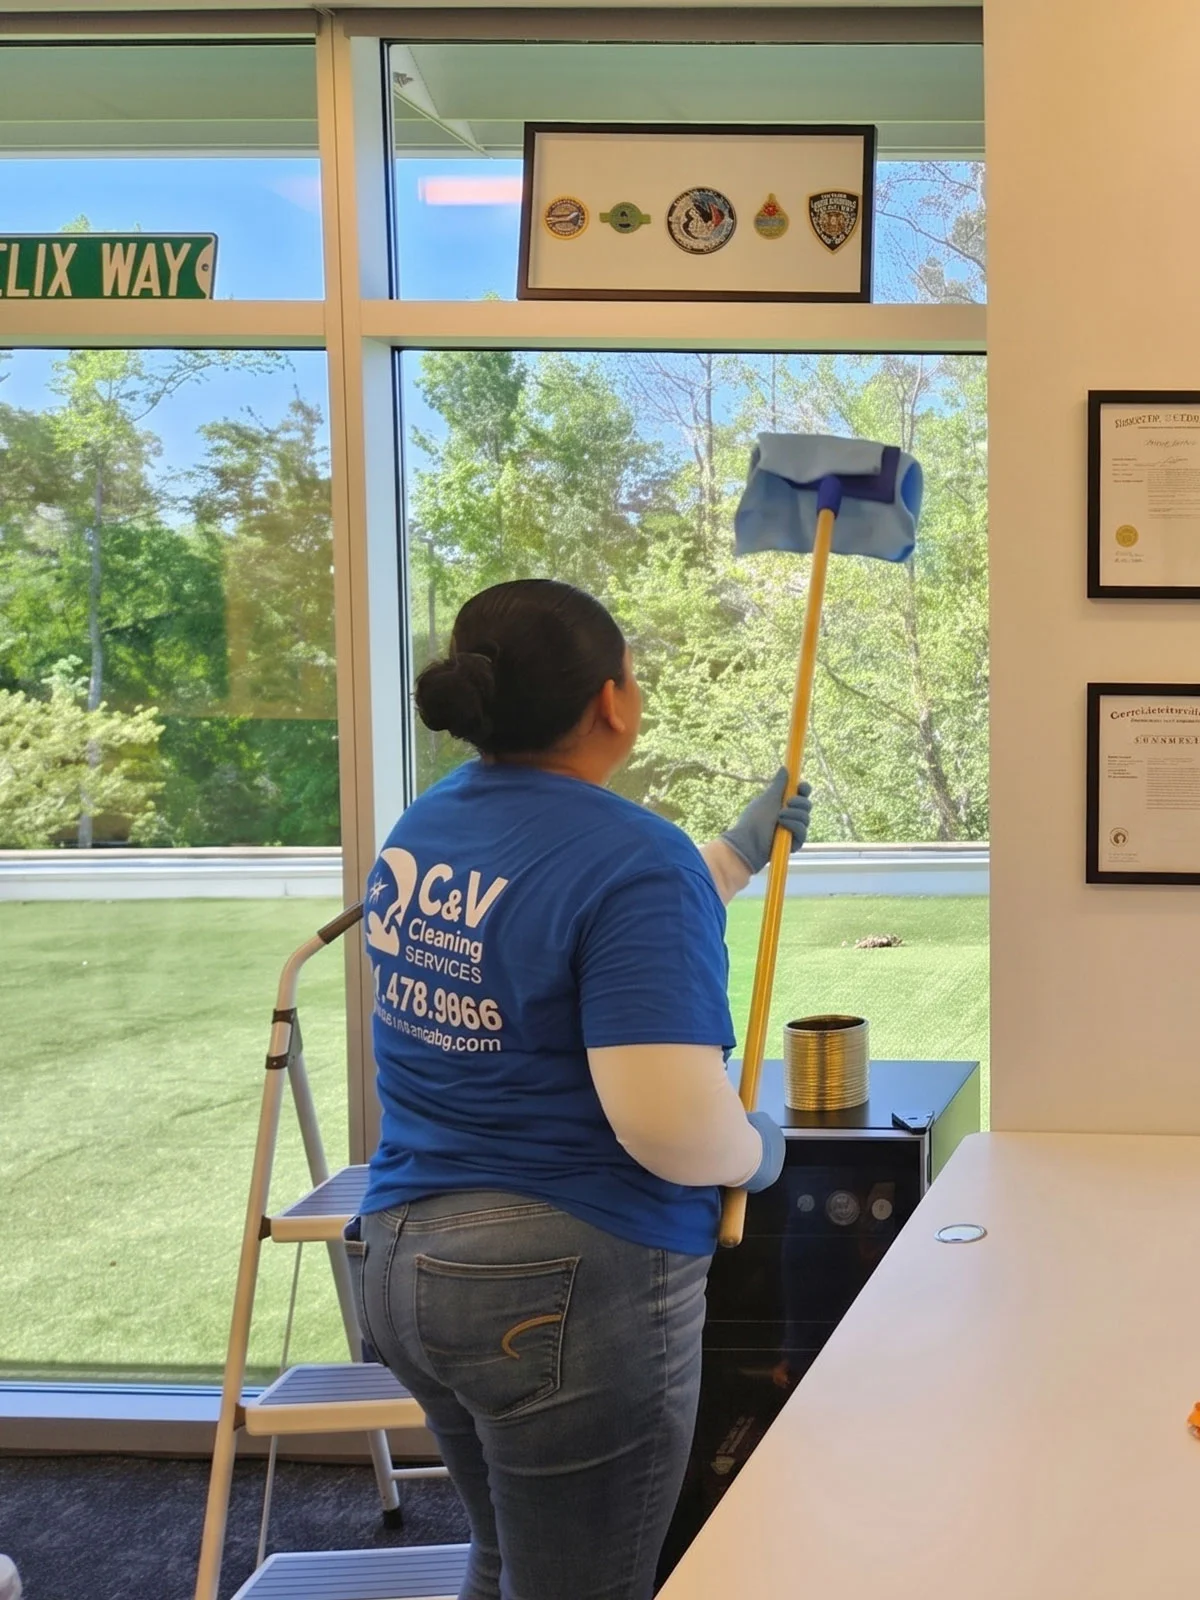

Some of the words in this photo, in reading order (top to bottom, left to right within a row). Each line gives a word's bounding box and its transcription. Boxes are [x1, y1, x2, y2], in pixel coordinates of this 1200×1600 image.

[0, 243, 78, 297] LIX
[102, 243, 192, 297] WAY
[419, 863, 509, 928] C&V
[405, 945, 482, 984] SERVICES
[408, 918, 483, 963] Cleaning
